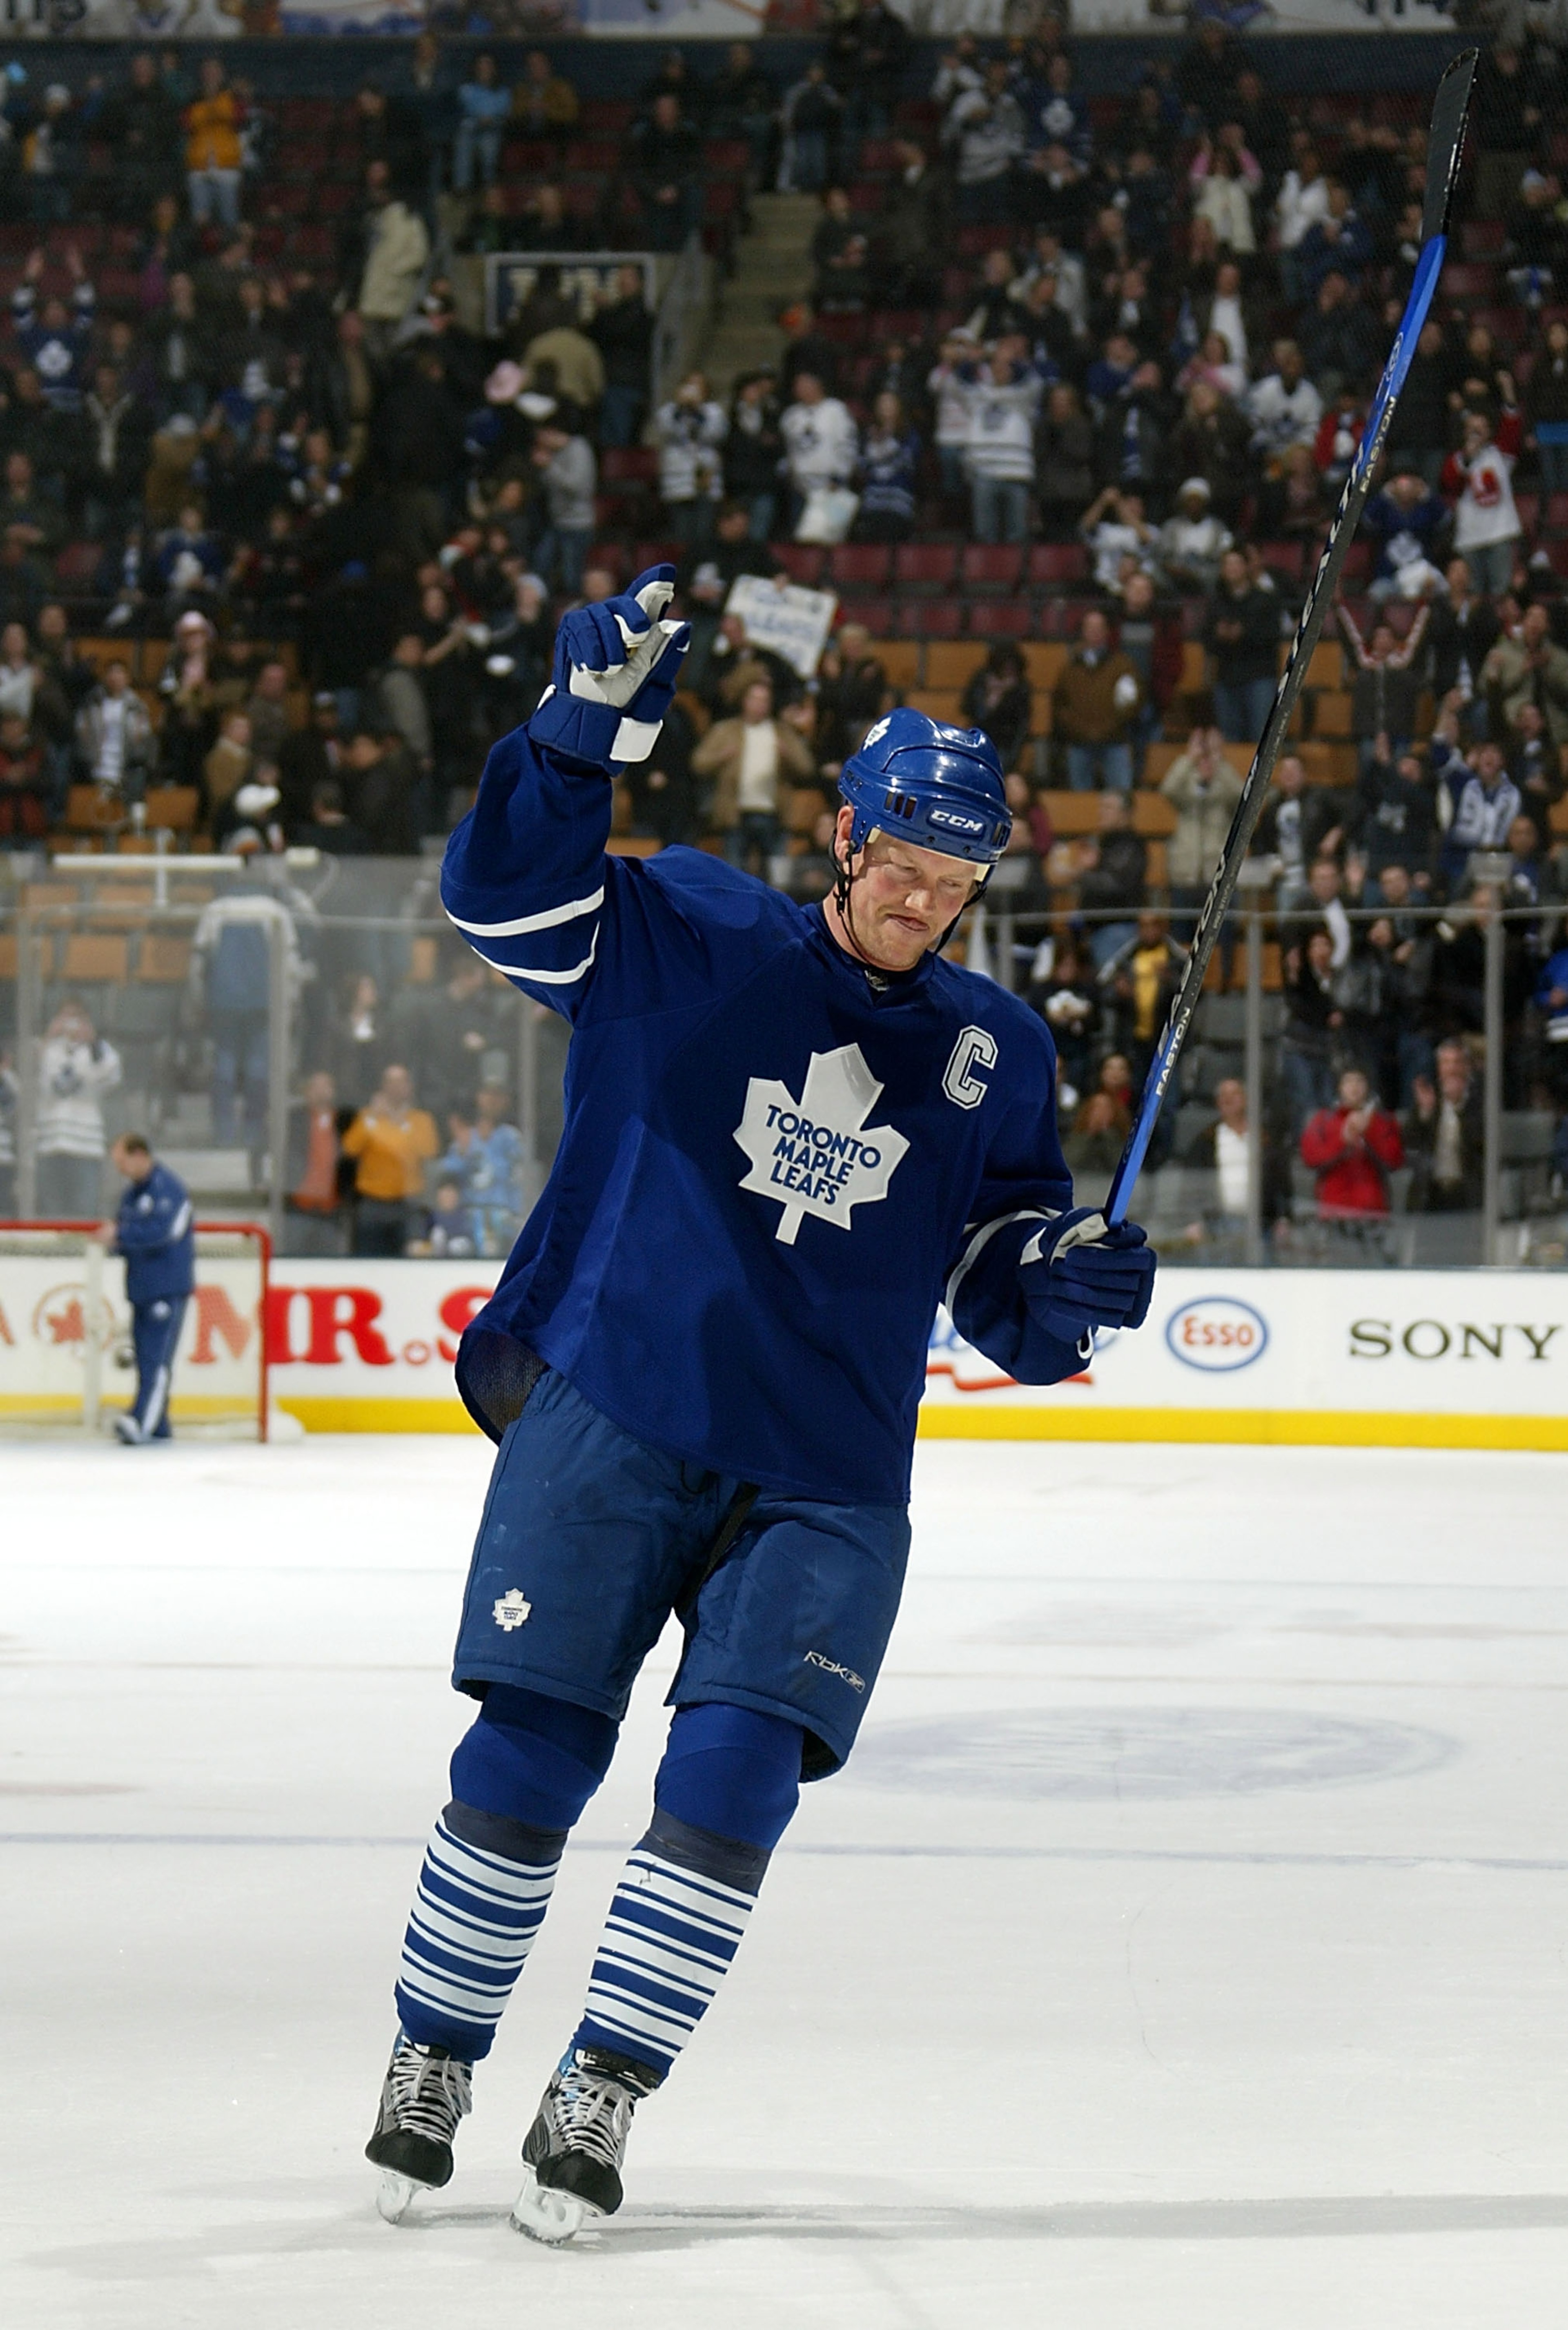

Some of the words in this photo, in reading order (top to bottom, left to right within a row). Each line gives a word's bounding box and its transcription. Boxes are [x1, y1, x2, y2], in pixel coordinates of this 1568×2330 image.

[1359, 395, 1397, 492] EASTON
[931, 810, 982, 831] CCM
[1158, 851, 1225, 1058] EASTON
[942, 1024, 998, 1110] C
[1155, 1006, 1191, 1097] EASTON
[766, 1104, 881, 1168] TORONTO
[773, 1136, 854, 1185] MAPLE
[770, 1160, 840, 1205] LEAFS
[1182, 1314, 1255, 1348] Esso
[1349, 1319, 1563, 1361] SONY
